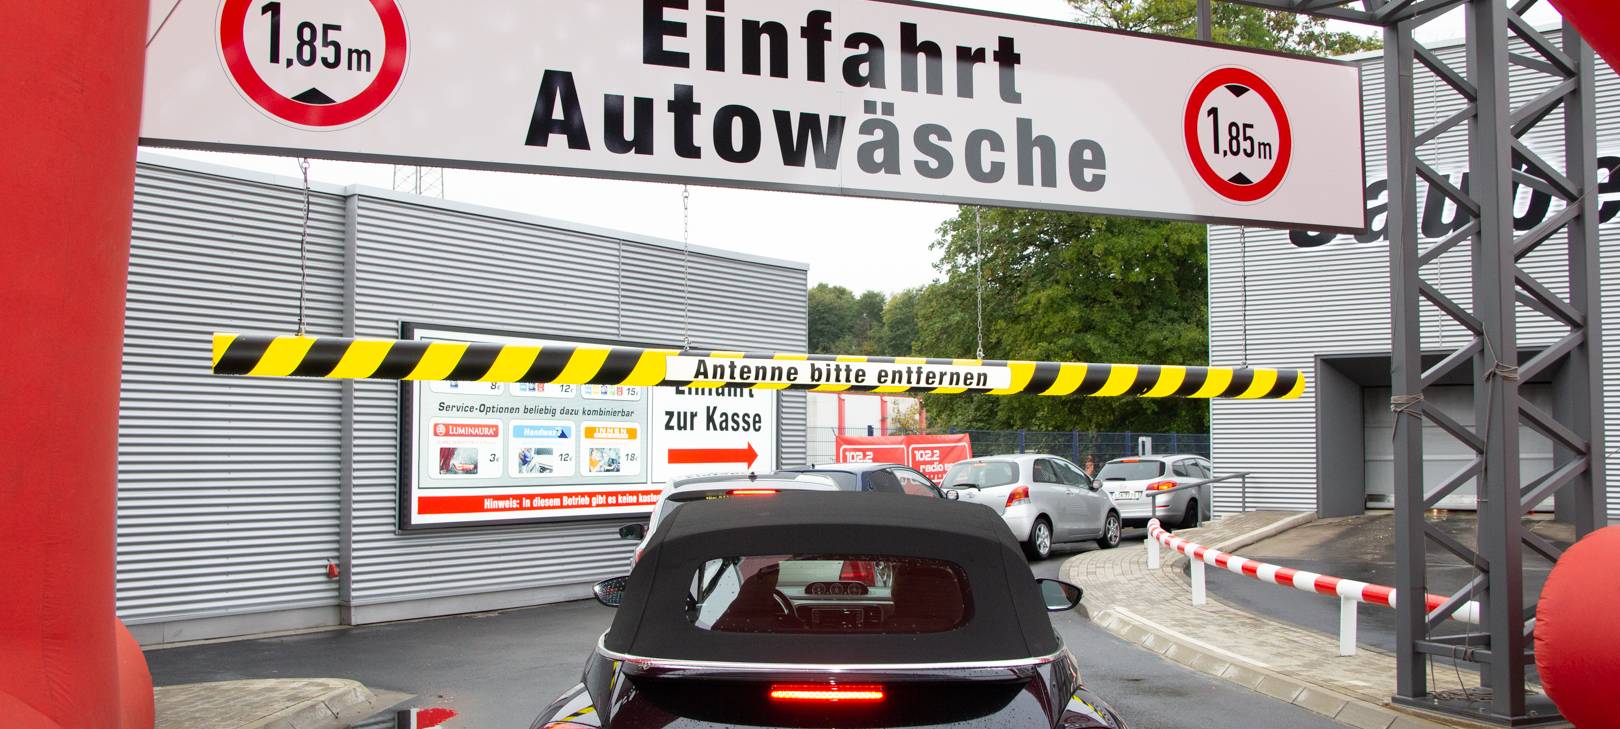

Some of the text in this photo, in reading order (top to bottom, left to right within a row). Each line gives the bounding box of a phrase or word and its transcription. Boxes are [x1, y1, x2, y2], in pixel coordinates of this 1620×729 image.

[642, 0, 1022, 104] Einfahrt
[524, 69, 1107, 193] Autowäsche
[693, 358, 989, 388] Antenne bitte entfernen
[438, 402, 635, 418] Service-Optionen beliebig dazu kombinierbar
[664, 405, 762, 432] zur Kasse
[845, 451, 874, 463] 102.2
[913, 449, 940, 461] 102.2
[919, 461, 944, 473] radio
[484, 498, 520, 509] Hinweis:
[533, 496, 561, 507] diesem
[562, 495, 590, 506] Betrieb
[591, 494, 607, 507] gibt
[607, 495, 617, 504] es
[618, 494, 637, 504] keine
